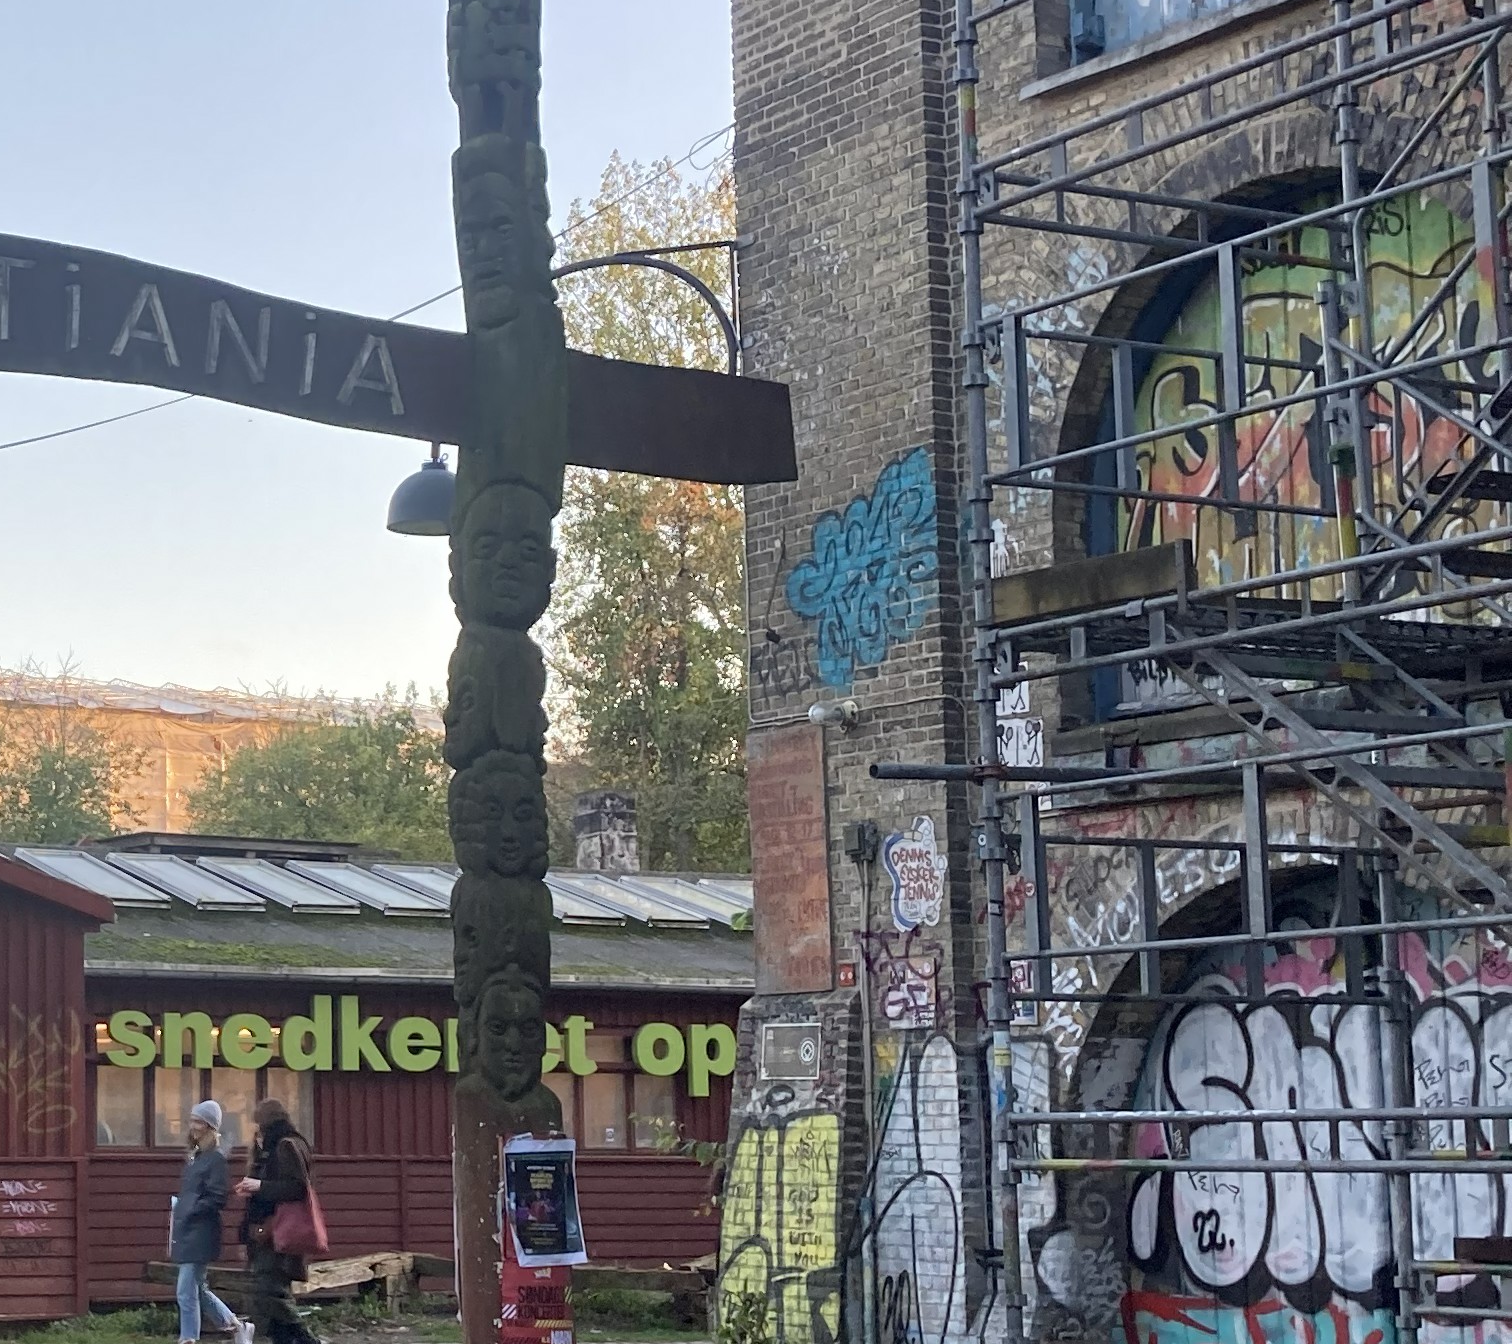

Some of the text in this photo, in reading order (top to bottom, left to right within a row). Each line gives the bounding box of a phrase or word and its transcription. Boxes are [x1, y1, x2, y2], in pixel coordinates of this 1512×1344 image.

[891, 847, 932, 868] DENNIS
[899, 881, 939, 902] TENNIS
[633, 1022, 738, 1098] op
